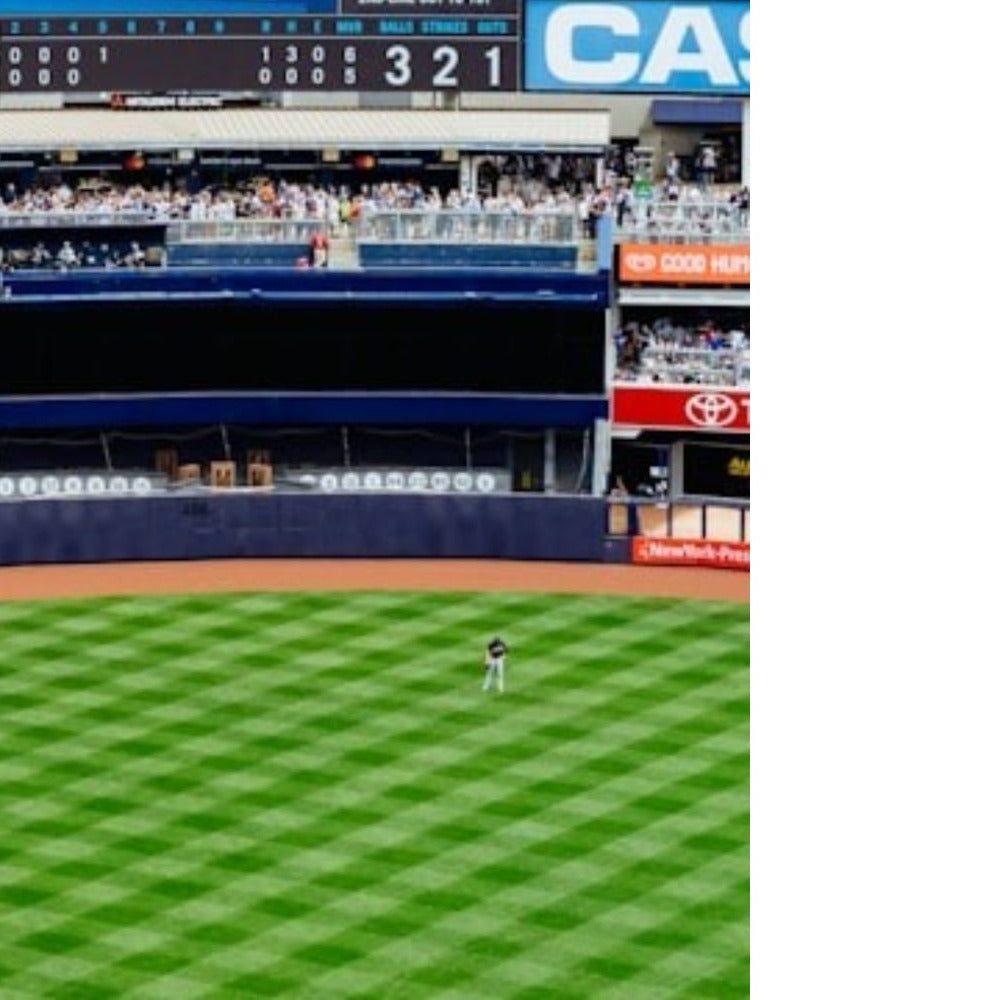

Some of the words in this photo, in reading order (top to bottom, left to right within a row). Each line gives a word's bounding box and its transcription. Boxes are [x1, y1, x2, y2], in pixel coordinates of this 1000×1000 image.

[545, 3, 750, 84] CA
[8, 46, 22, 64] 0
[66, 46, 80, 64] 0
[99, 46, 107, 63] 1
[261, 46, 270, 63] 1
[285, 46, 298, 63] 3
[311, 46, 325, 63] 0
[385, 44, 412, 86] 3
[432, 45, 459, 86] 2
[484, 45, 501, 86] 1
[8, 68, 22, 86] 0
[66, 68, 80, 86] 0
[258, 67, 272, 85] 0
[311, 67, 325, 85] 0
[660, 252, 707, 274] GOOD
